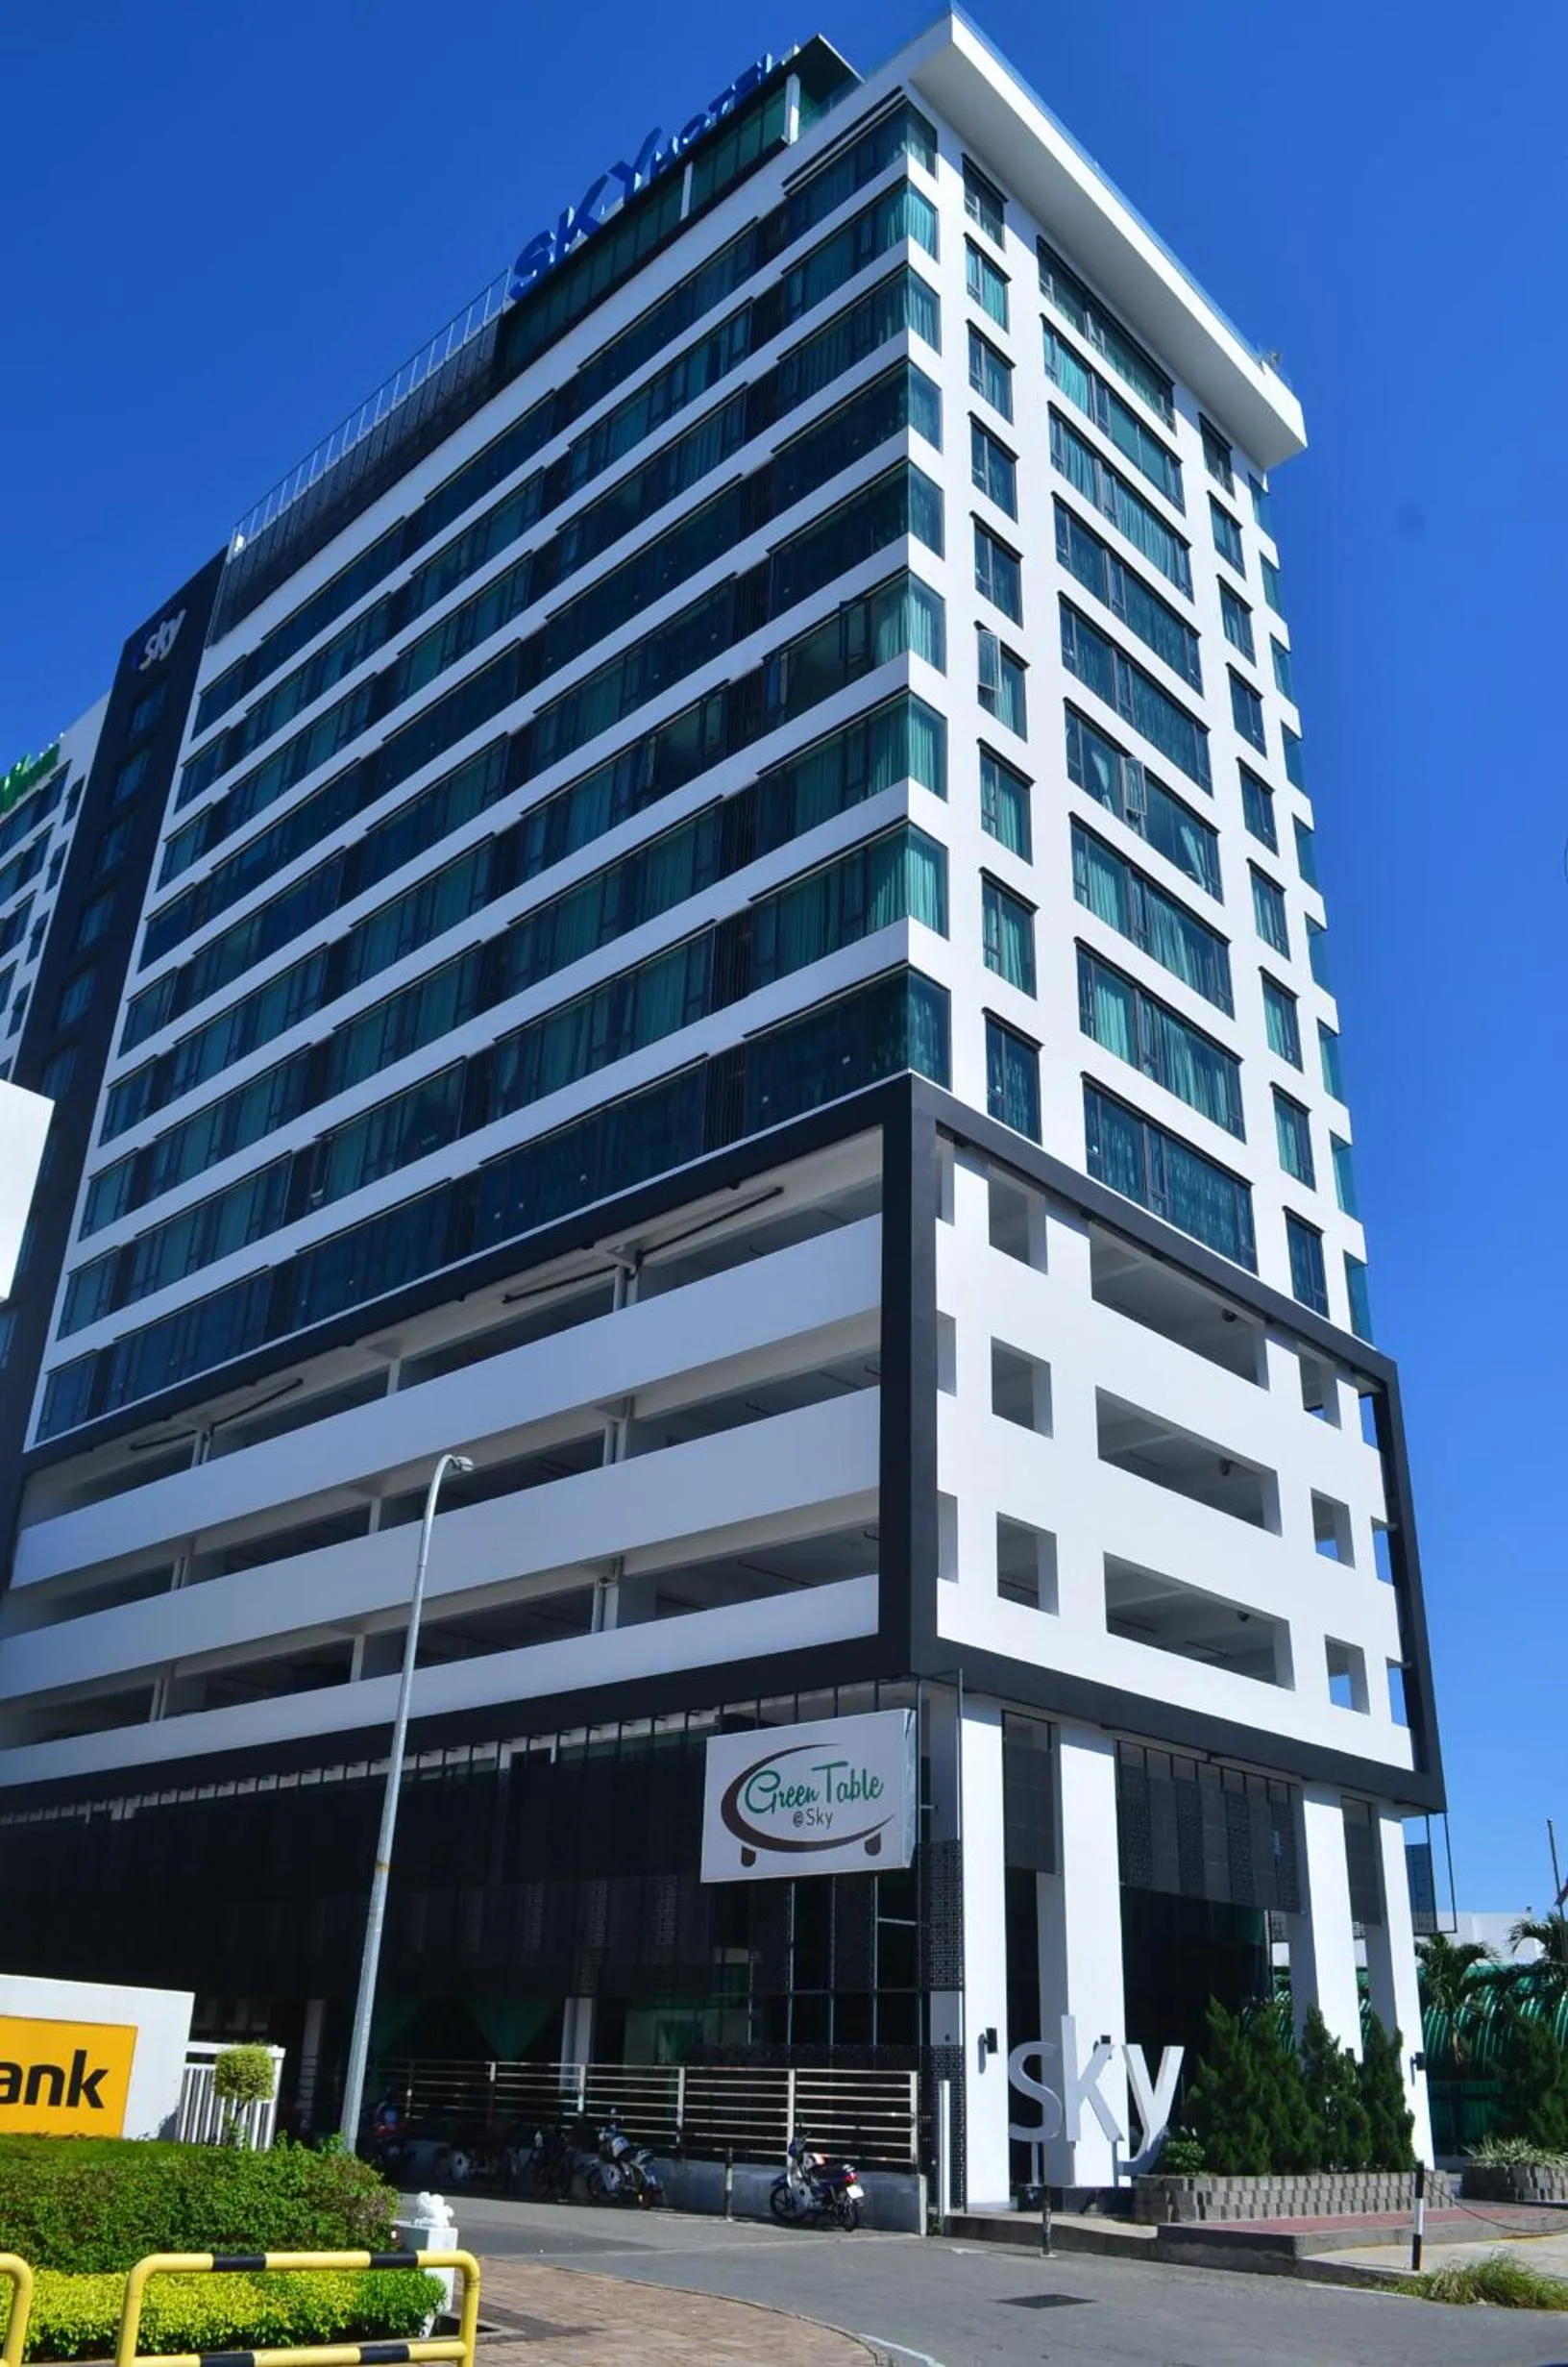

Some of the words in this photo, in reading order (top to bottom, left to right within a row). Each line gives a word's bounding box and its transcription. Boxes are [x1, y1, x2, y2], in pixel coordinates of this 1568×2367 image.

[509, 126, 663, 302] SKY
[745, 1769, 820, 1814] Green
[811, 1761, 883, 1804] Table
[793, 1808, 833, 1830] @Sky
